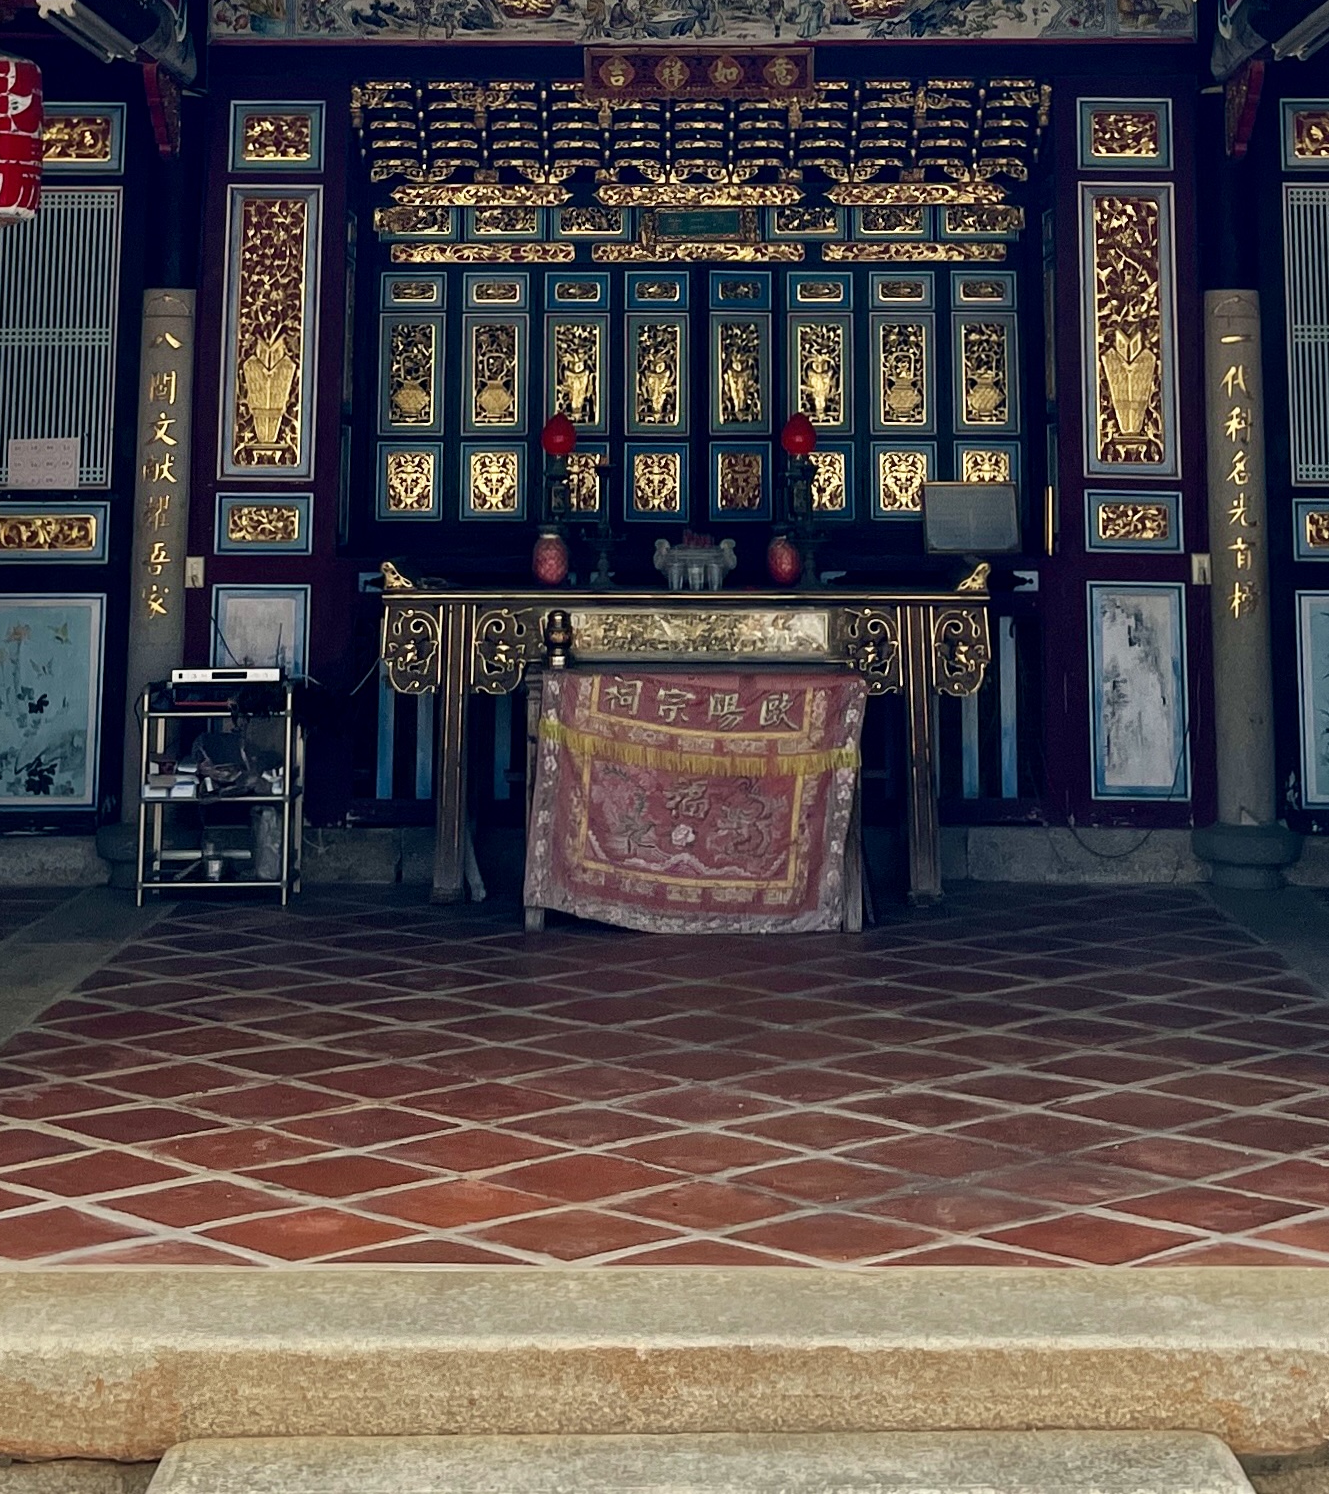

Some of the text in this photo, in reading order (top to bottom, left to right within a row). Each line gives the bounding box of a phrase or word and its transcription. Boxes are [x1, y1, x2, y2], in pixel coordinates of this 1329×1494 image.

[607, 57, 794, 88] 吉祥如意
[604, 676, 800, 731] 歐陽宗祠
